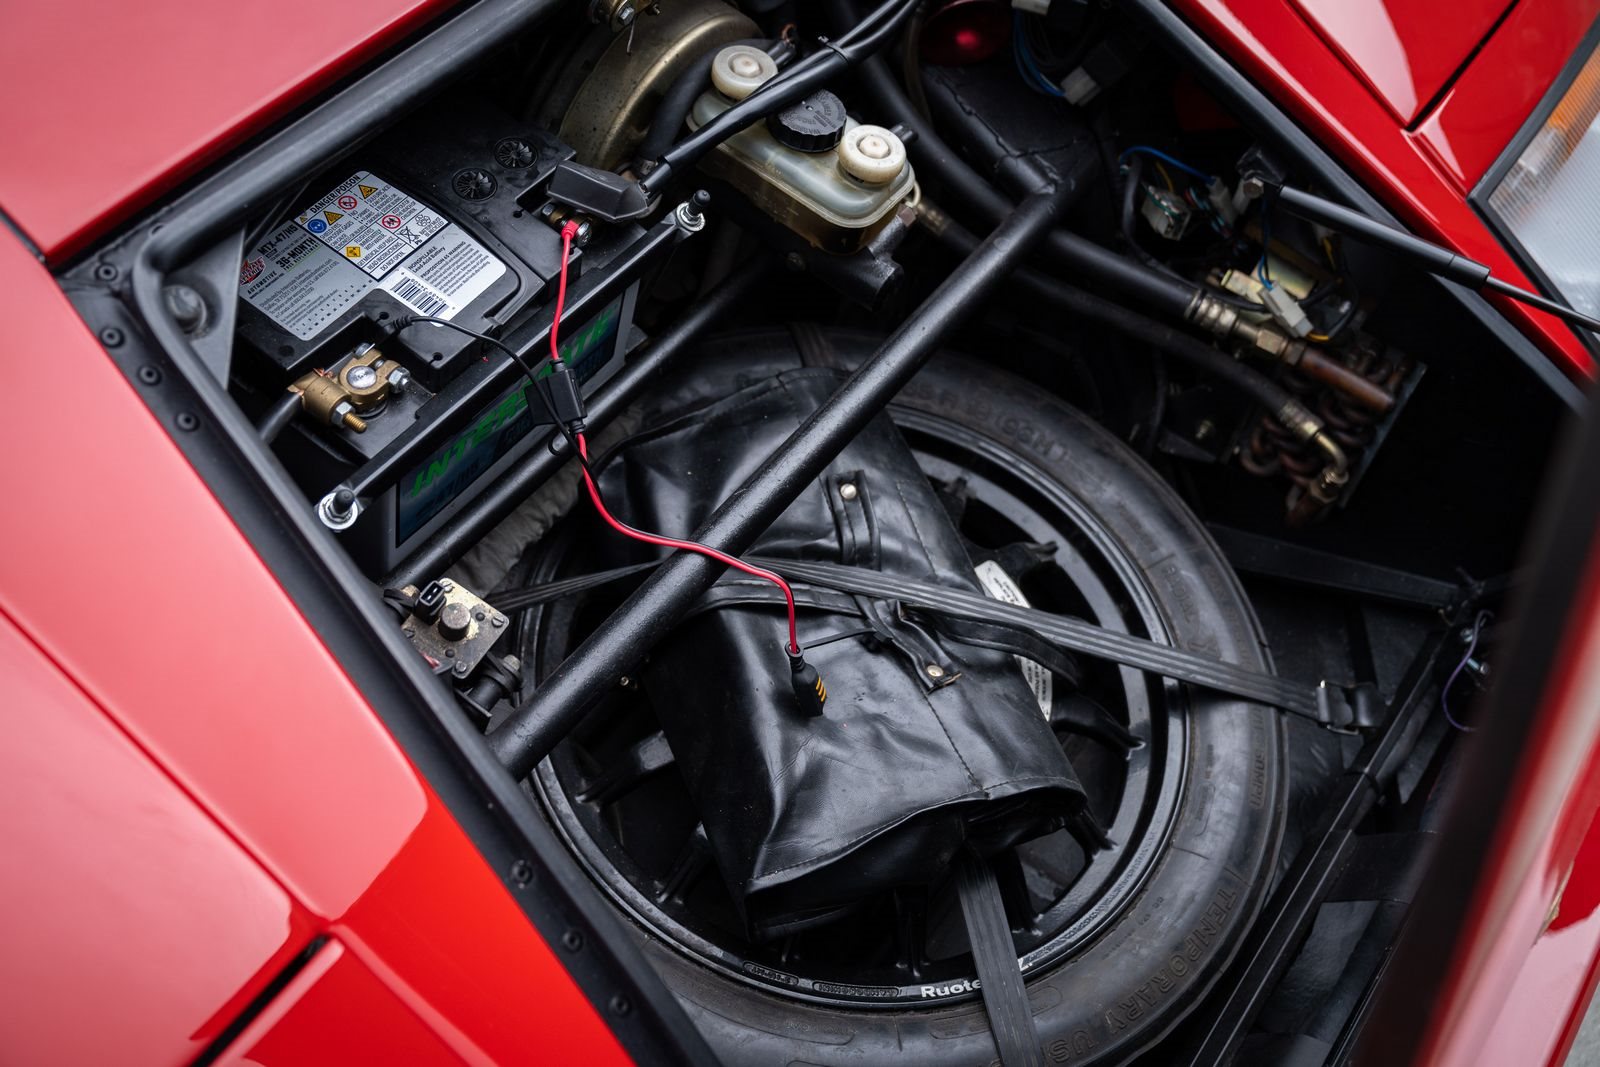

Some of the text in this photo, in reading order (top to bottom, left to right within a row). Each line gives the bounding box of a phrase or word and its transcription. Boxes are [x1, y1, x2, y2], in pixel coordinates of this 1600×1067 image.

[309, 173, 361, 214] DANGER/POISON
[256, 222, 299, 256] MTX-47/H5
[274, 235, 317, 269] 36-MONTH
[429, 245, 447, 259] Battery
[406, 245, 438, 270] NONSPILLABLE
[245, 269, 278, 295] AUTOMOTIVE
[1103, 888, 1237, 1034] TEMPORARY
[920, 978, 983, 998] Ruote
